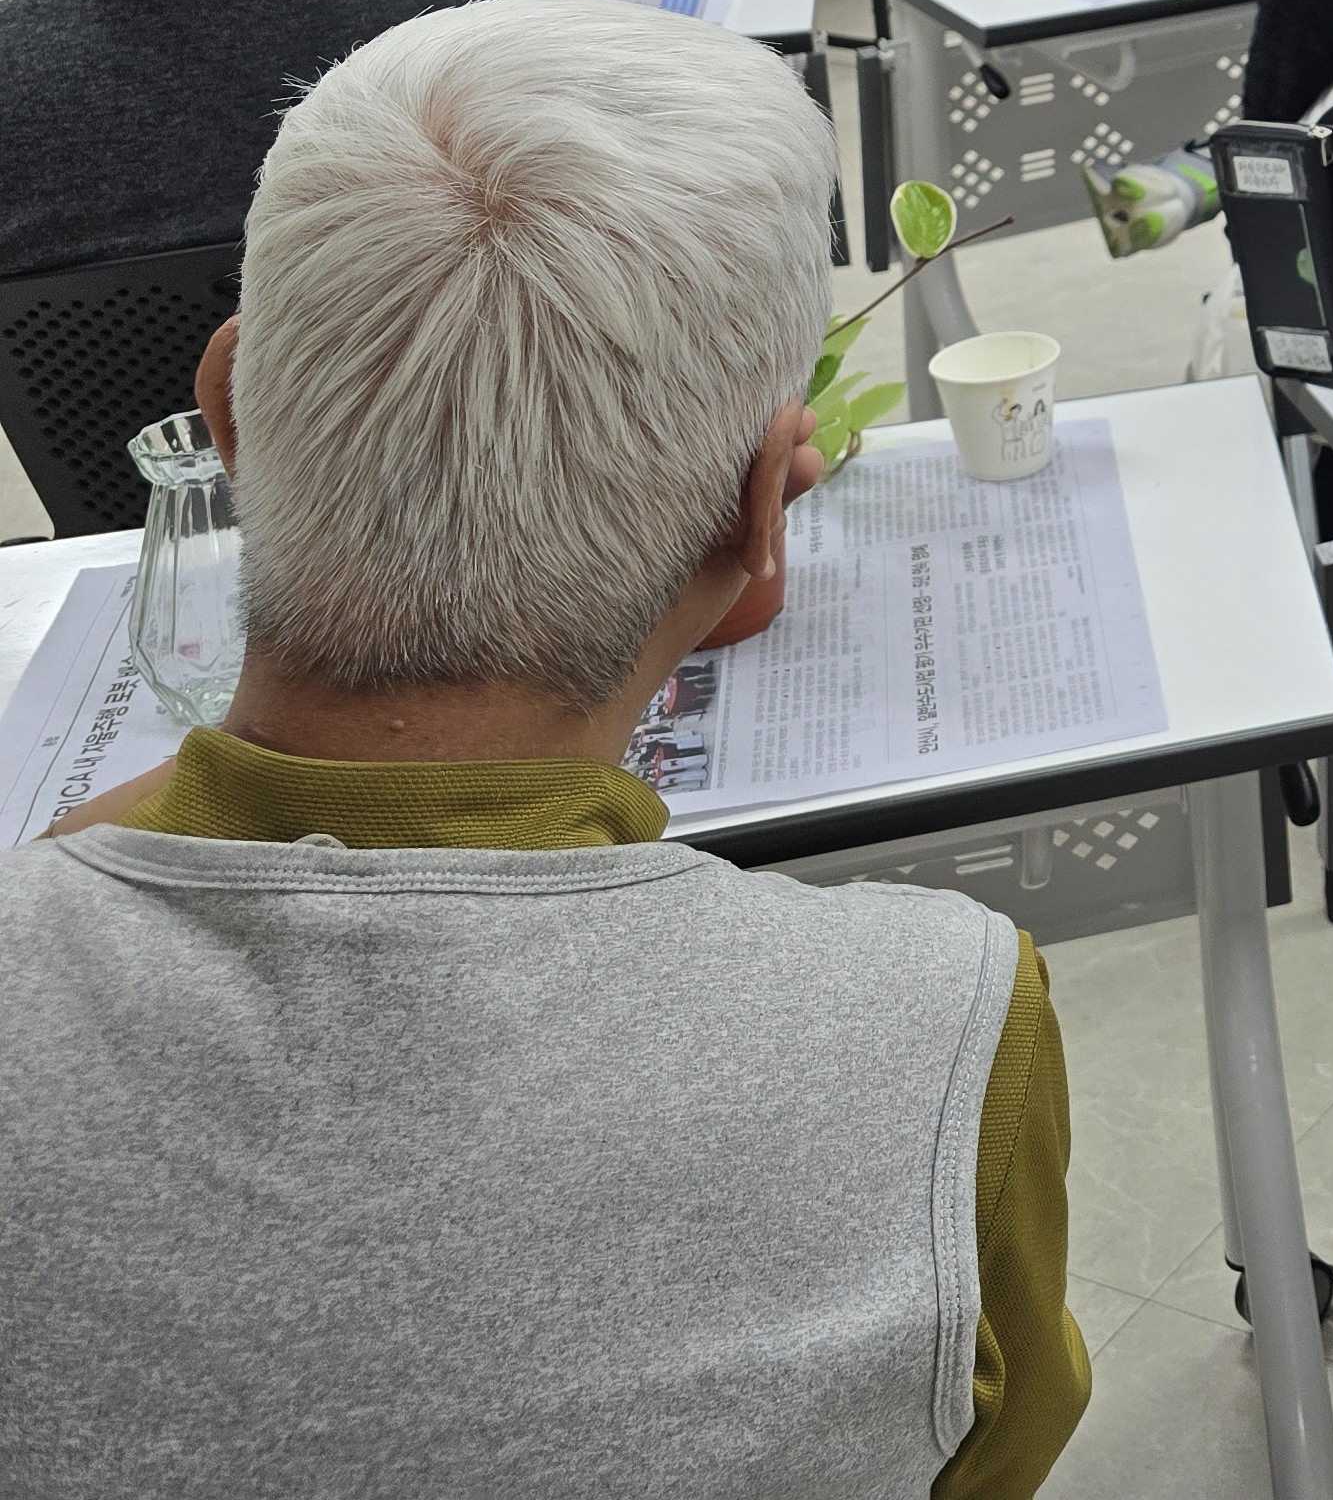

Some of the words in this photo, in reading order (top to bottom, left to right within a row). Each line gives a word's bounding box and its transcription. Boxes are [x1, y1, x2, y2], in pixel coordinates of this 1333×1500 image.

[912, 615, 935, 650] 우수기관
[102, 678, 140, 704] 로봇
[80, 705, 130, 755] 자율주행
[71, 753, 108, 768] 내
[52, 770, 95, 822] RICA
